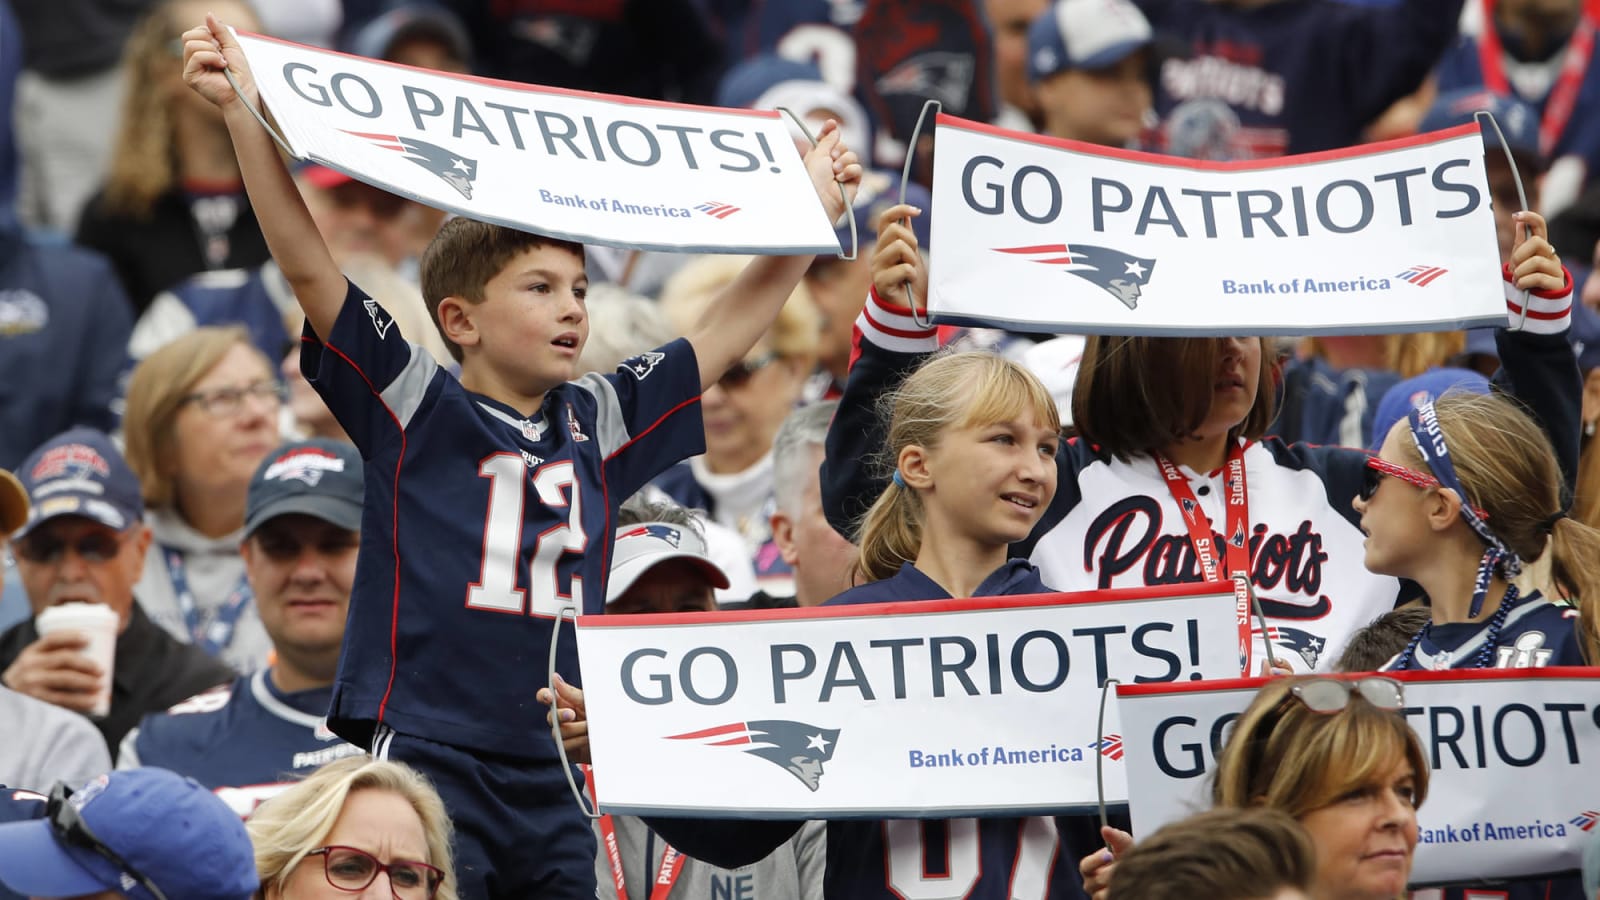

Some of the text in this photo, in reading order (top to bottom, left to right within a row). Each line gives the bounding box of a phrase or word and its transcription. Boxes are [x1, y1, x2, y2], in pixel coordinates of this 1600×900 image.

[282, 62, 783, 174] GO PATRIOTS!
[538, 189, 692, 218] Bank of America
[961, 155, 1493, 239] GO PATRIOTS
[1222, 278, 1391, 294] Bank of America
[1230, 458, 1245, 505] PATRIOTS
[464, 450, 589, 621] 12
[620, 618, 1201, 706] GO PATRIOTS!
[909, 744, 1084, 768] Bank of America
[1460, 822, 1481, 843] of
[1483, 819, 1567, 842] America
